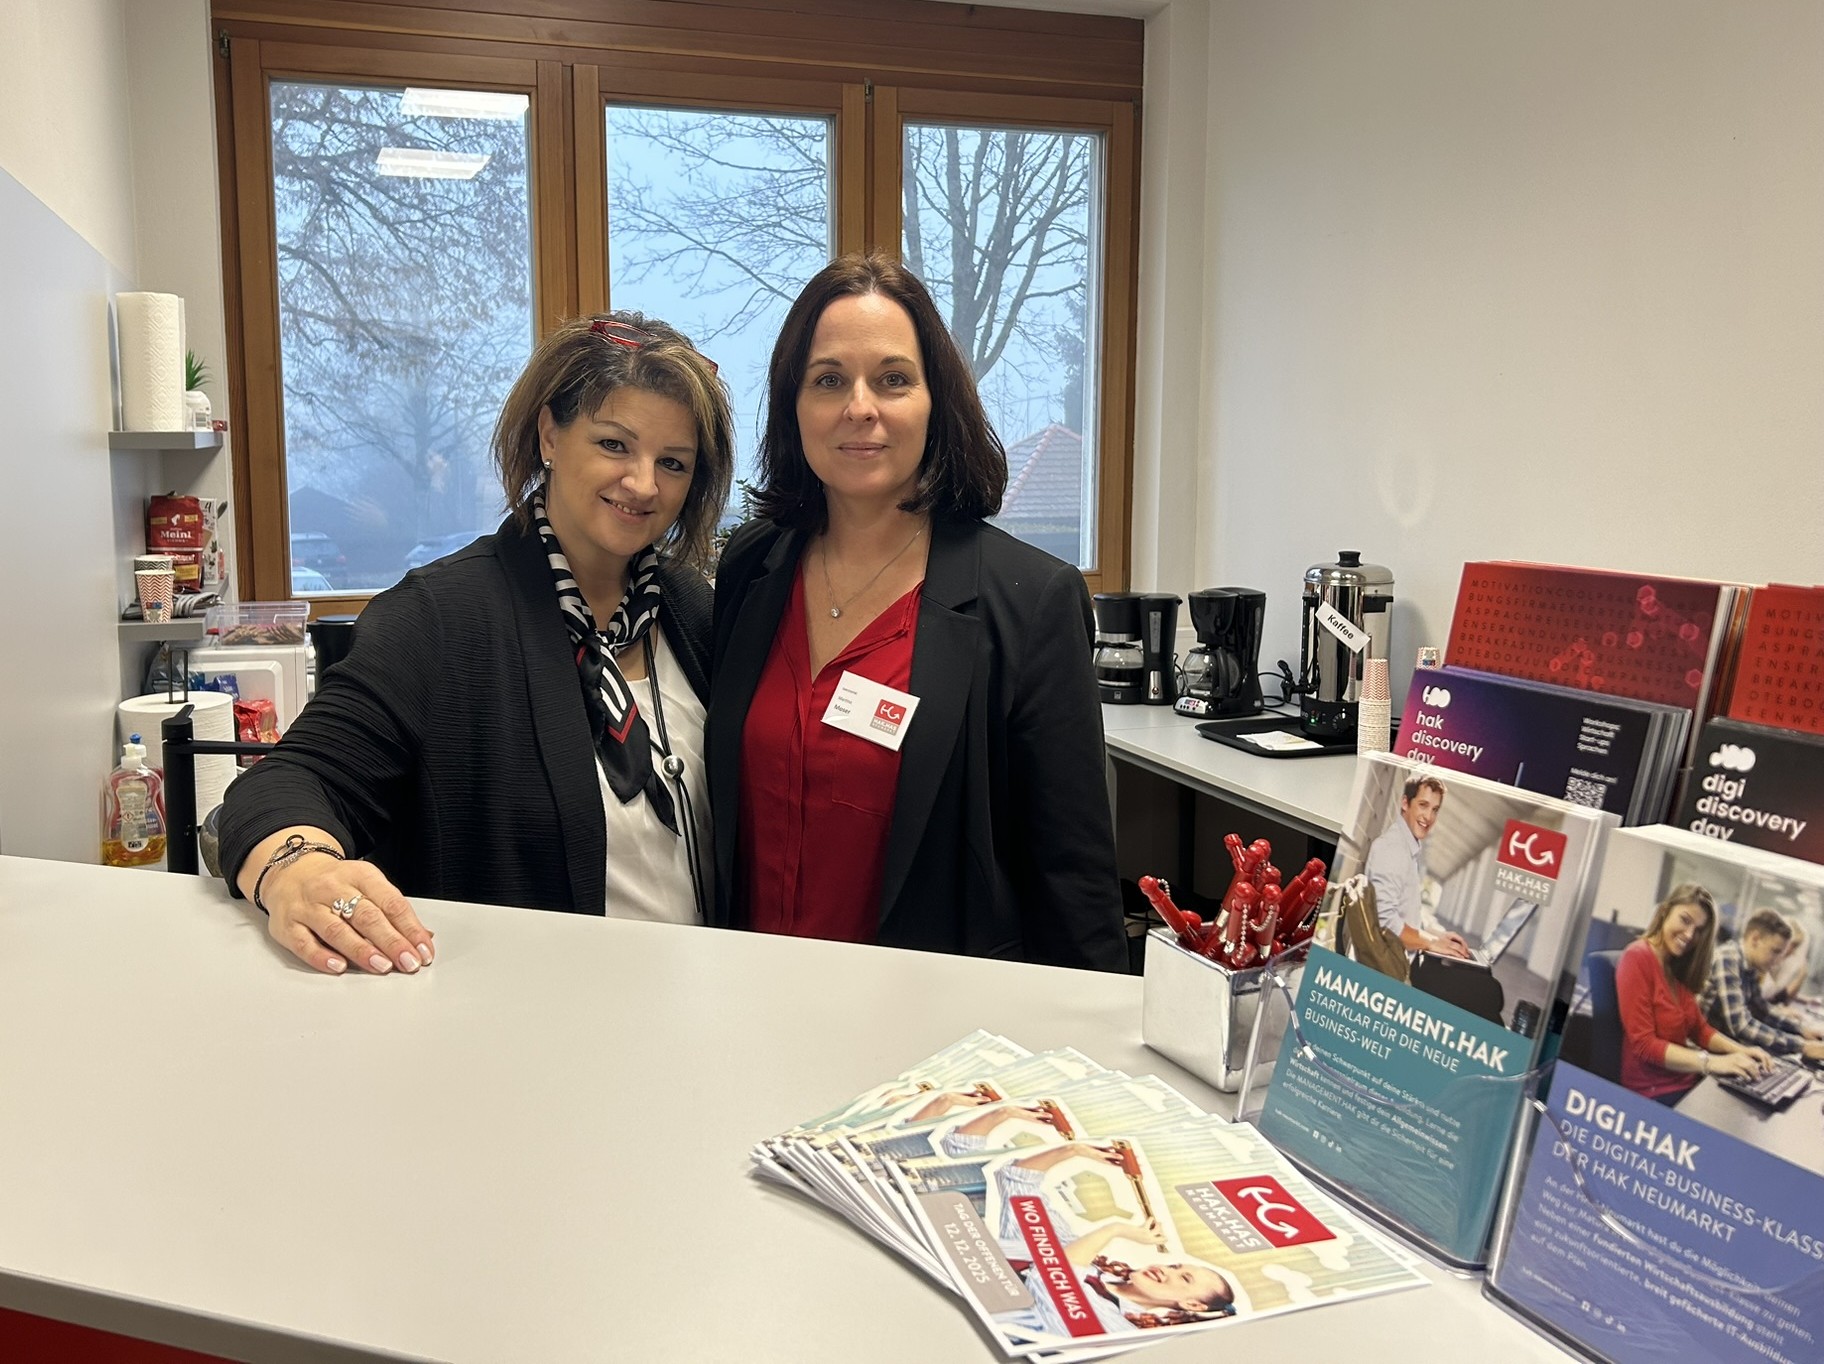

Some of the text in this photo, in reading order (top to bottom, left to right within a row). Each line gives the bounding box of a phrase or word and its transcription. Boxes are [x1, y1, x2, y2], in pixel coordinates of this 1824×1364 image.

[160, 530, 192, 539] Meinl
[1327, 614, 1354, 640] Kaffee
[1411, 730, 1483, 762] discovery
[1416, 710, 1444, 730] hak
[1702, 773, 1746, 801] digi
[1696, 796, 1807, 841] discovery
[1497, 868, 1550, 893] HAK.HAS
[1304, 1008, 1392, 1060] BUSINESS-WELT
[1309, 990, 1460, 1073] STARTKLAR FÜR DIE NEUE
[1314, 965, 1509, 1072] MANAGEMENT.HAK
[1565, 1088, 1700, 1171] DIGI.HAK
[1185, 1189, 1245, 1248] NEUMARKT
[1195, 1187, 1262, 1247] HAK.HAS
[1560, 1120, 1824, 1260] DIE DIGITAL-BUSINESS-KLASS
[1593, 1160, 1629, 1190] HAK
[1633, 1181, 1736, 1243] NEUMARKT
[944, 1223, 960, 1239] 12.
[963, 1256, 990, 1284] 2025
[953, 1202, 1020, 1297] TAG DER OFFENEN TÜR
[1020, 1200, 1087, 1321] WO FINDE ICH WAS
